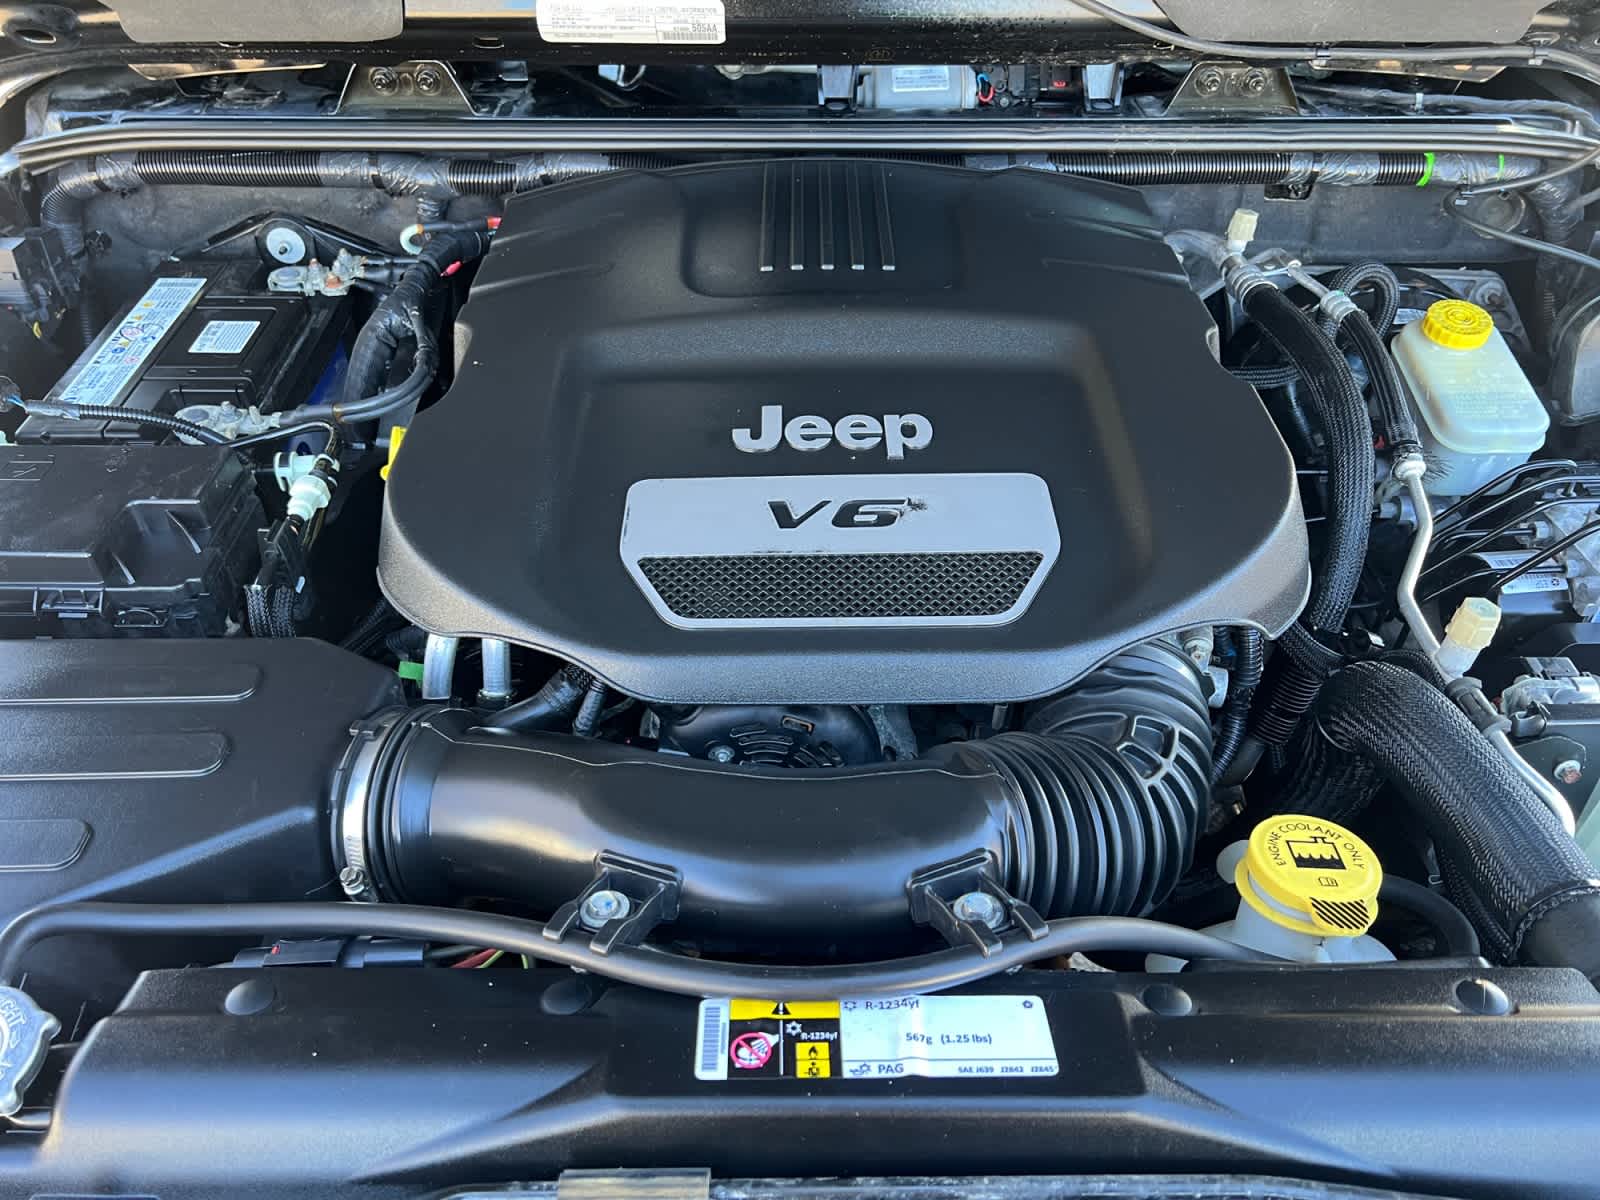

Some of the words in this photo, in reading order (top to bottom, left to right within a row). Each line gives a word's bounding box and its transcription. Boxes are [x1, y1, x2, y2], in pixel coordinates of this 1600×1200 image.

[732, 405, 934, 461] Jeep
[768, 498, 908, 530] V6
[1267, 831, 1287, 867] ENGINE
[1279, 822, 1343, 840] COOLANT
[1343, 842, 1365, 869] ONLY
[865, 998, 922, 1012] R-1234yf
[906, 1032, 933, 1044] 567g
[940, 1034, 970, 1044] (1.25
[972, 1034, 993, 1044] lbs)
[878, 1064, 905, 1075] PAG
[958, 1066, 974, 1074] SAE
